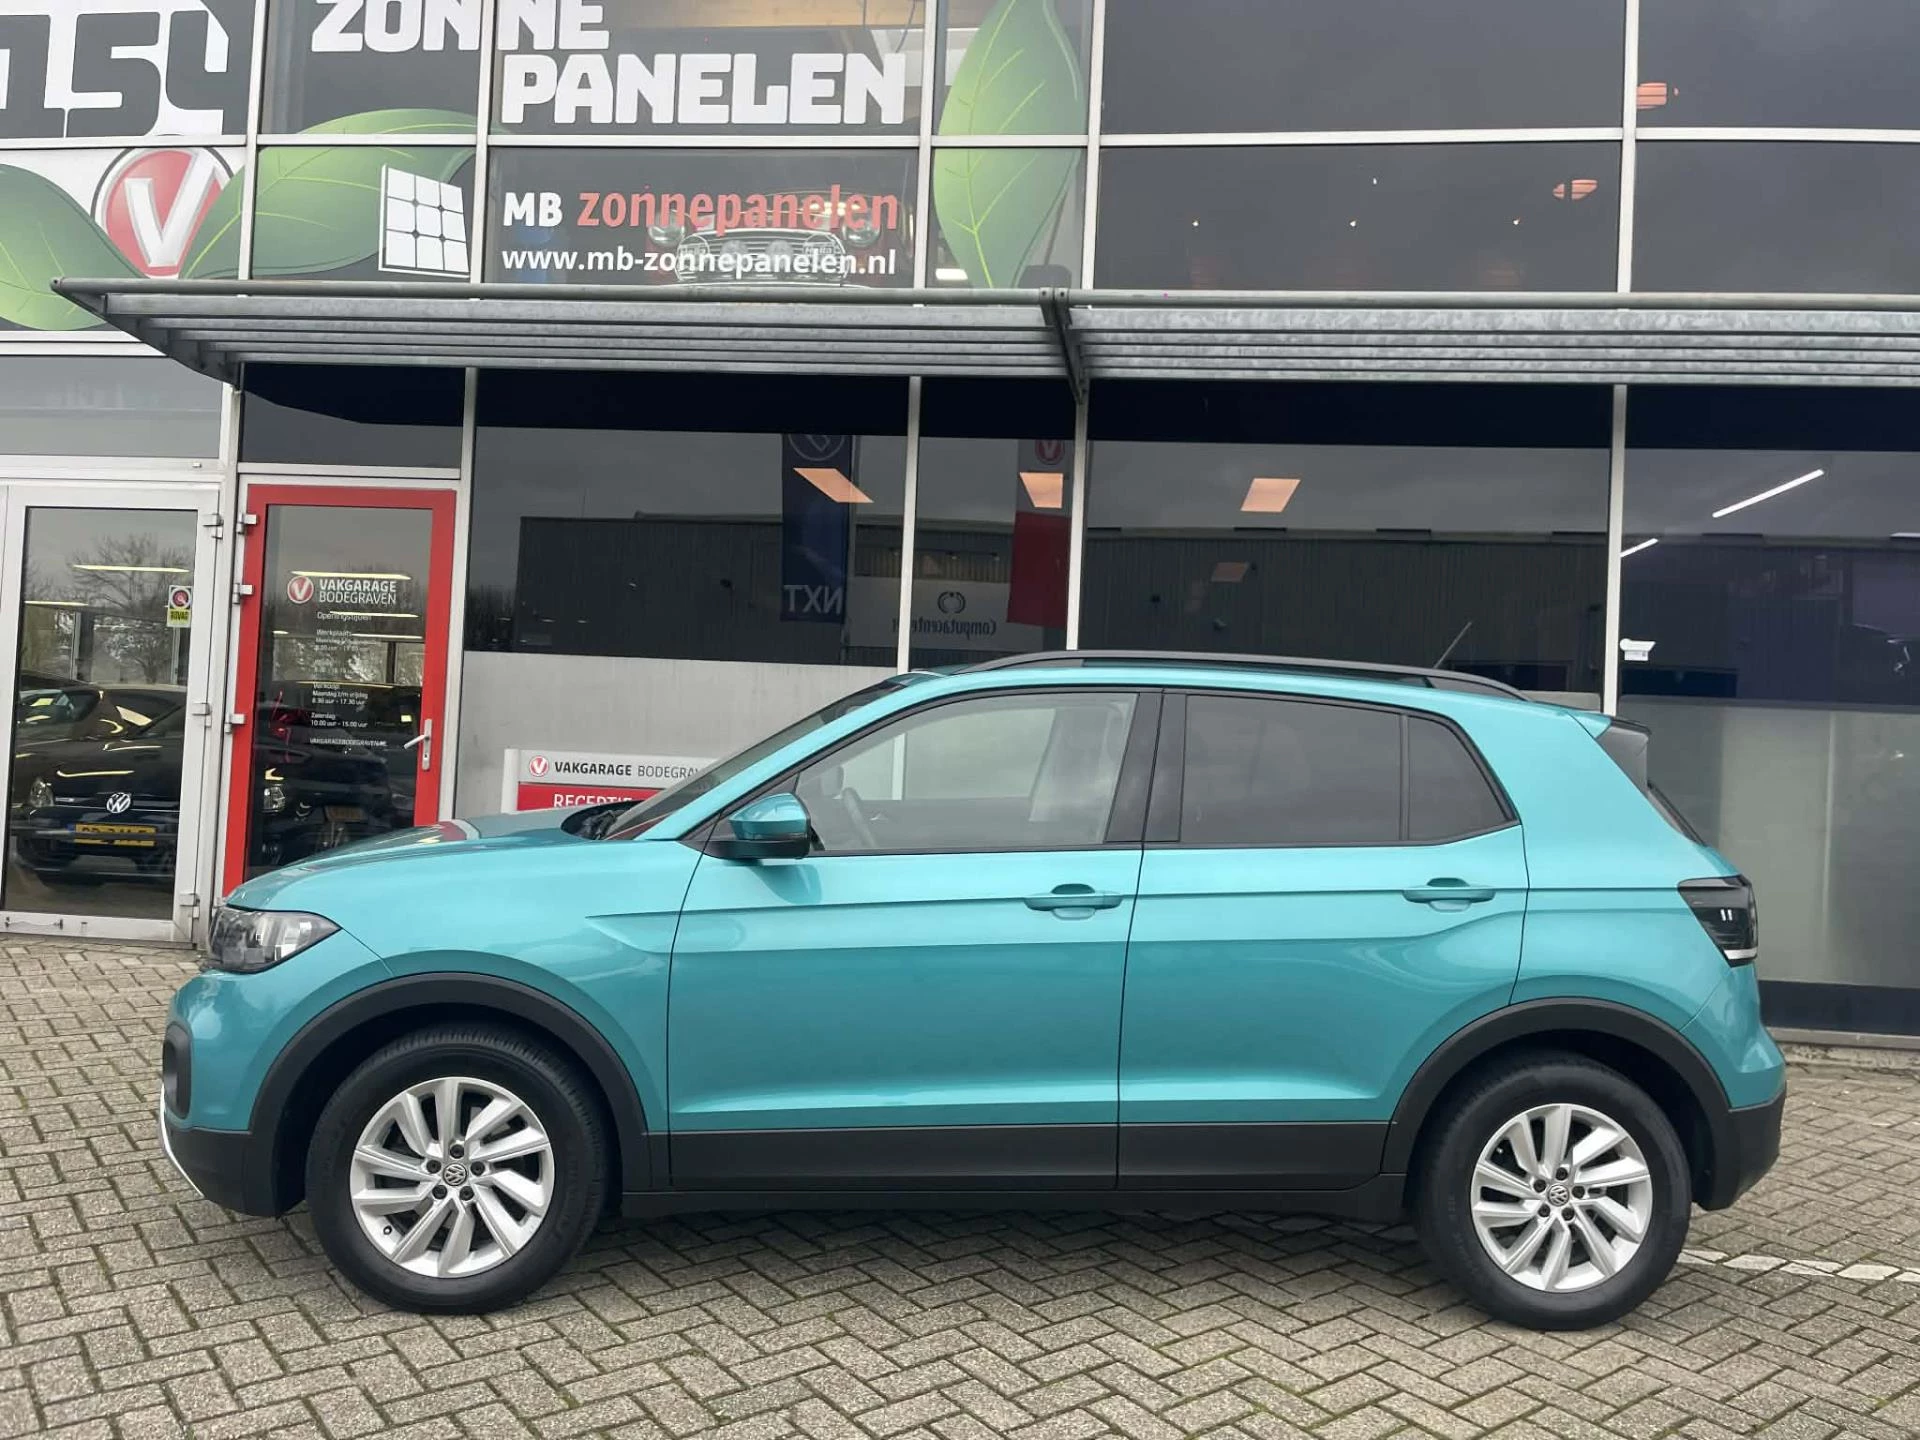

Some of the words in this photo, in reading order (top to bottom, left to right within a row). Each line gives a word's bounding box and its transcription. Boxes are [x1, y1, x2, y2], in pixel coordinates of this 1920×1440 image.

[311, 0, 610, 52] ZONNE
[501, 53, 905, 124] PANELEN
[503, 192, 563, 228] MB
[577, 184, 898, 237] zonnepanelen
[502, 249, 896, 280] www.mb-zonnepanelen.nl
[319, 591, 397, 605] BODEGRAVEN
[320, 579, 397, 593] VAKGARAGE
[555, 762, 632, 776] VAKGARAGE
